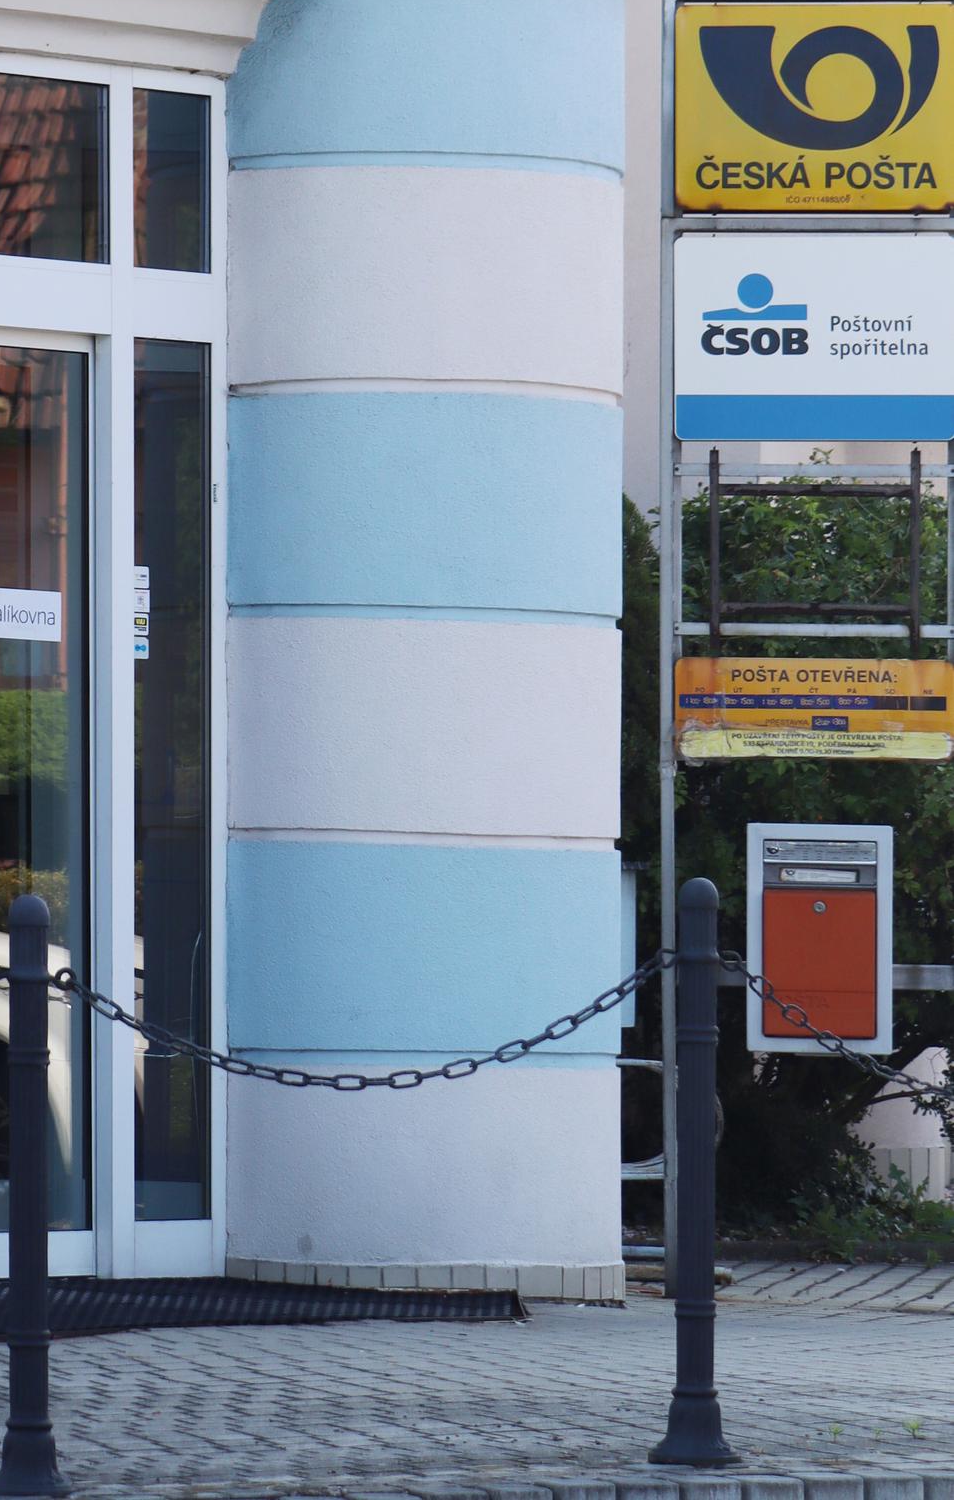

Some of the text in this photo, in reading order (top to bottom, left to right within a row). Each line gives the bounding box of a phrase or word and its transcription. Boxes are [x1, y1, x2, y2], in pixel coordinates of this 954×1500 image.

[696, 155, 937, 189] ČESKÁ POŠTA
[830, 315, 913, 332] Poštovní
[701, 323, 809, 356] ČSOB
[829, 338, 929, 359] spořitelna
[731, 665, 898, 683] POŠTA OTEVŘENA:
